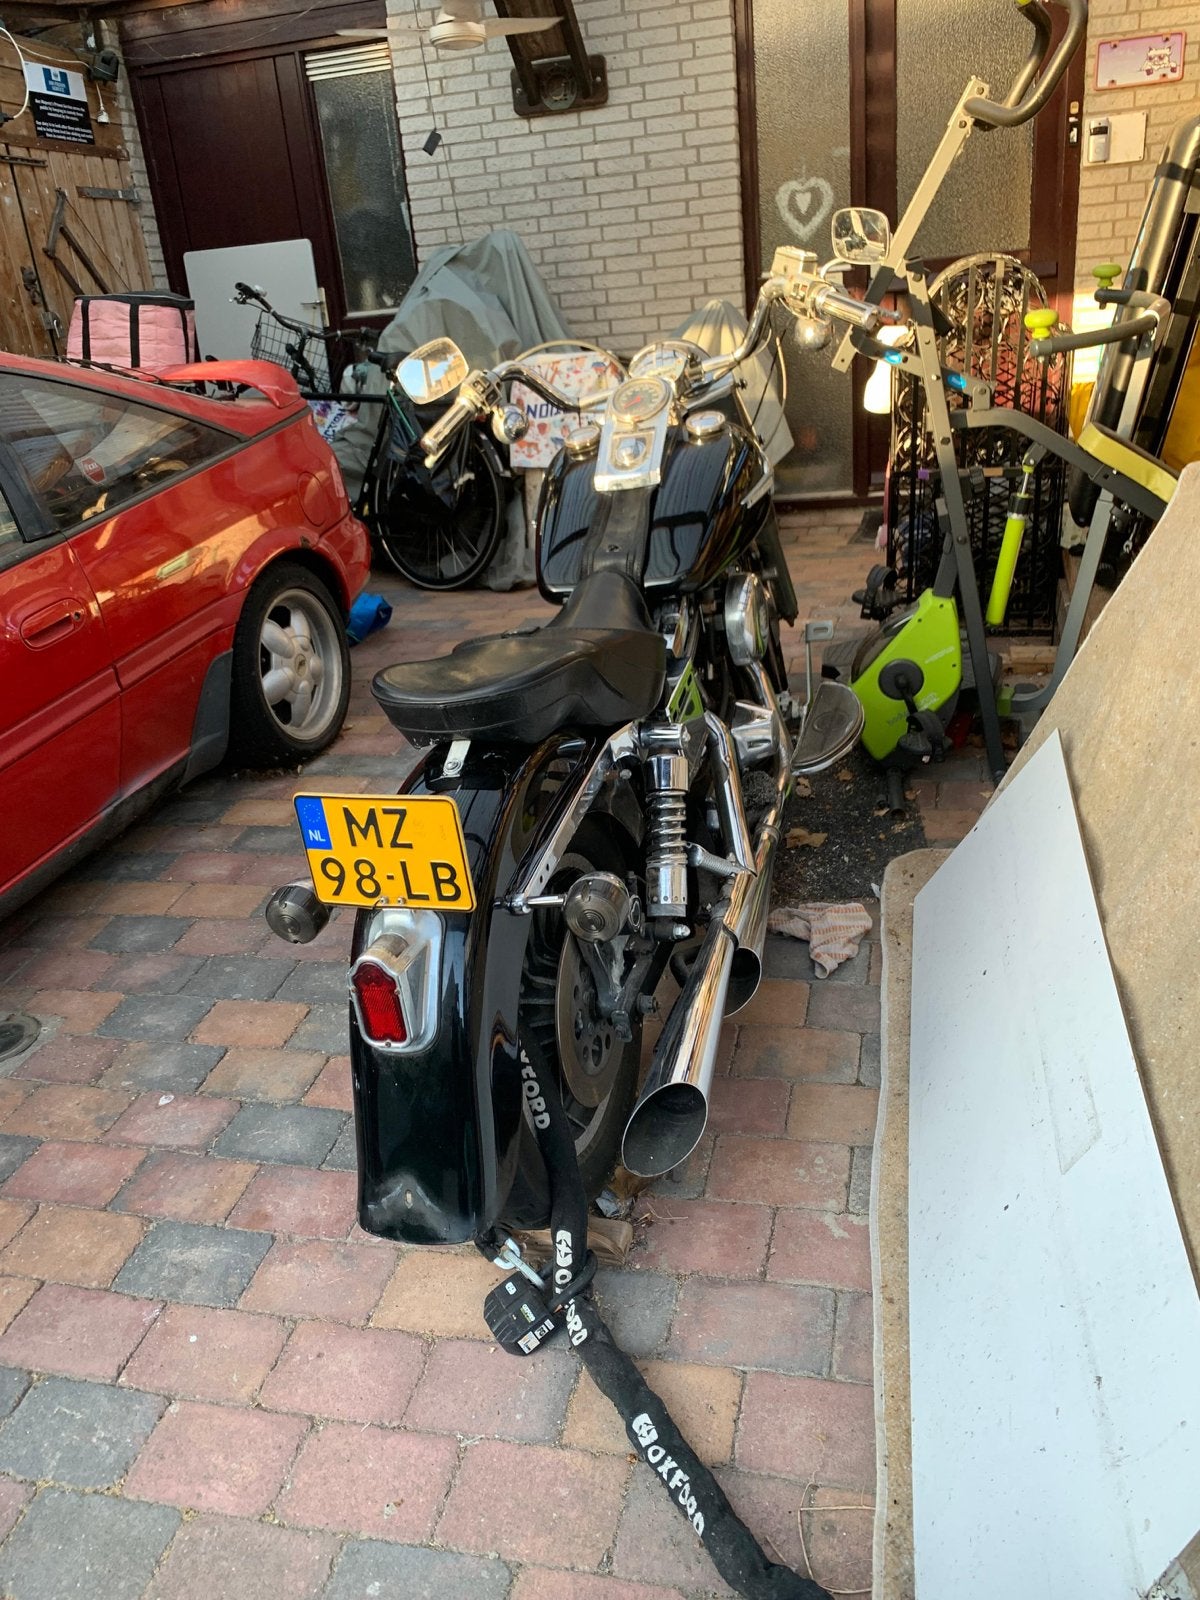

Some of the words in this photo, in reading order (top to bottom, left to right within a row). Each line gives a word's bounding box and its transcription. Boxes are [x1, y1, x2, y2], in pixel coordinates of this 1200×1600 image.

[308, 829, 326, 842] NL
[342, 806, 413, 849] MZ
[320, 857, 462, 902] 98-LB
[647, 1445, 705, 1536] OXFORD
